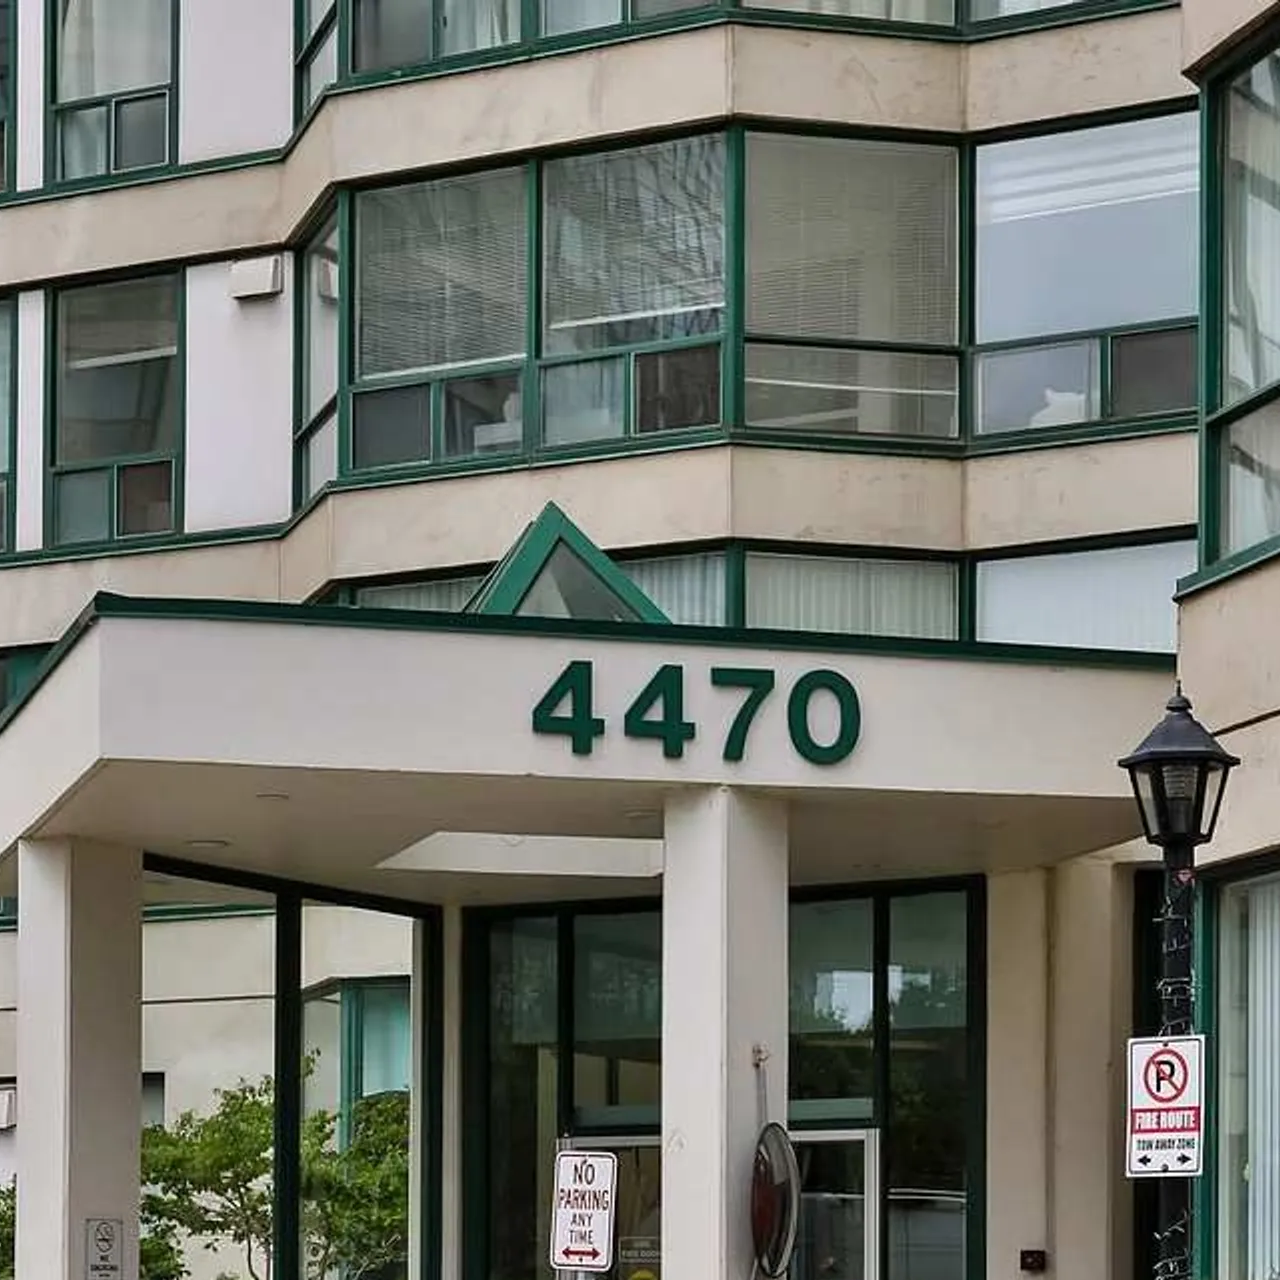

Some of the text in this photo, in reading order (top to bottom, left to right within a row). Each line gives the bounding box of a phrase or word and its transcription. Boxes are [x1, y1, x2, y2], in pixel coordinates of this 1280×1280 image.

[532, 660, 861, 765] 4470
[1136, 1110, 1196, 1130] FIRE ROUTE
[573, 1162, 595, 1185] NO
[558, 1187, 609, 1211] PARKING
[570, 1212, 593, 1227] ANY
[569, 1229, 593, 1245] TIME
